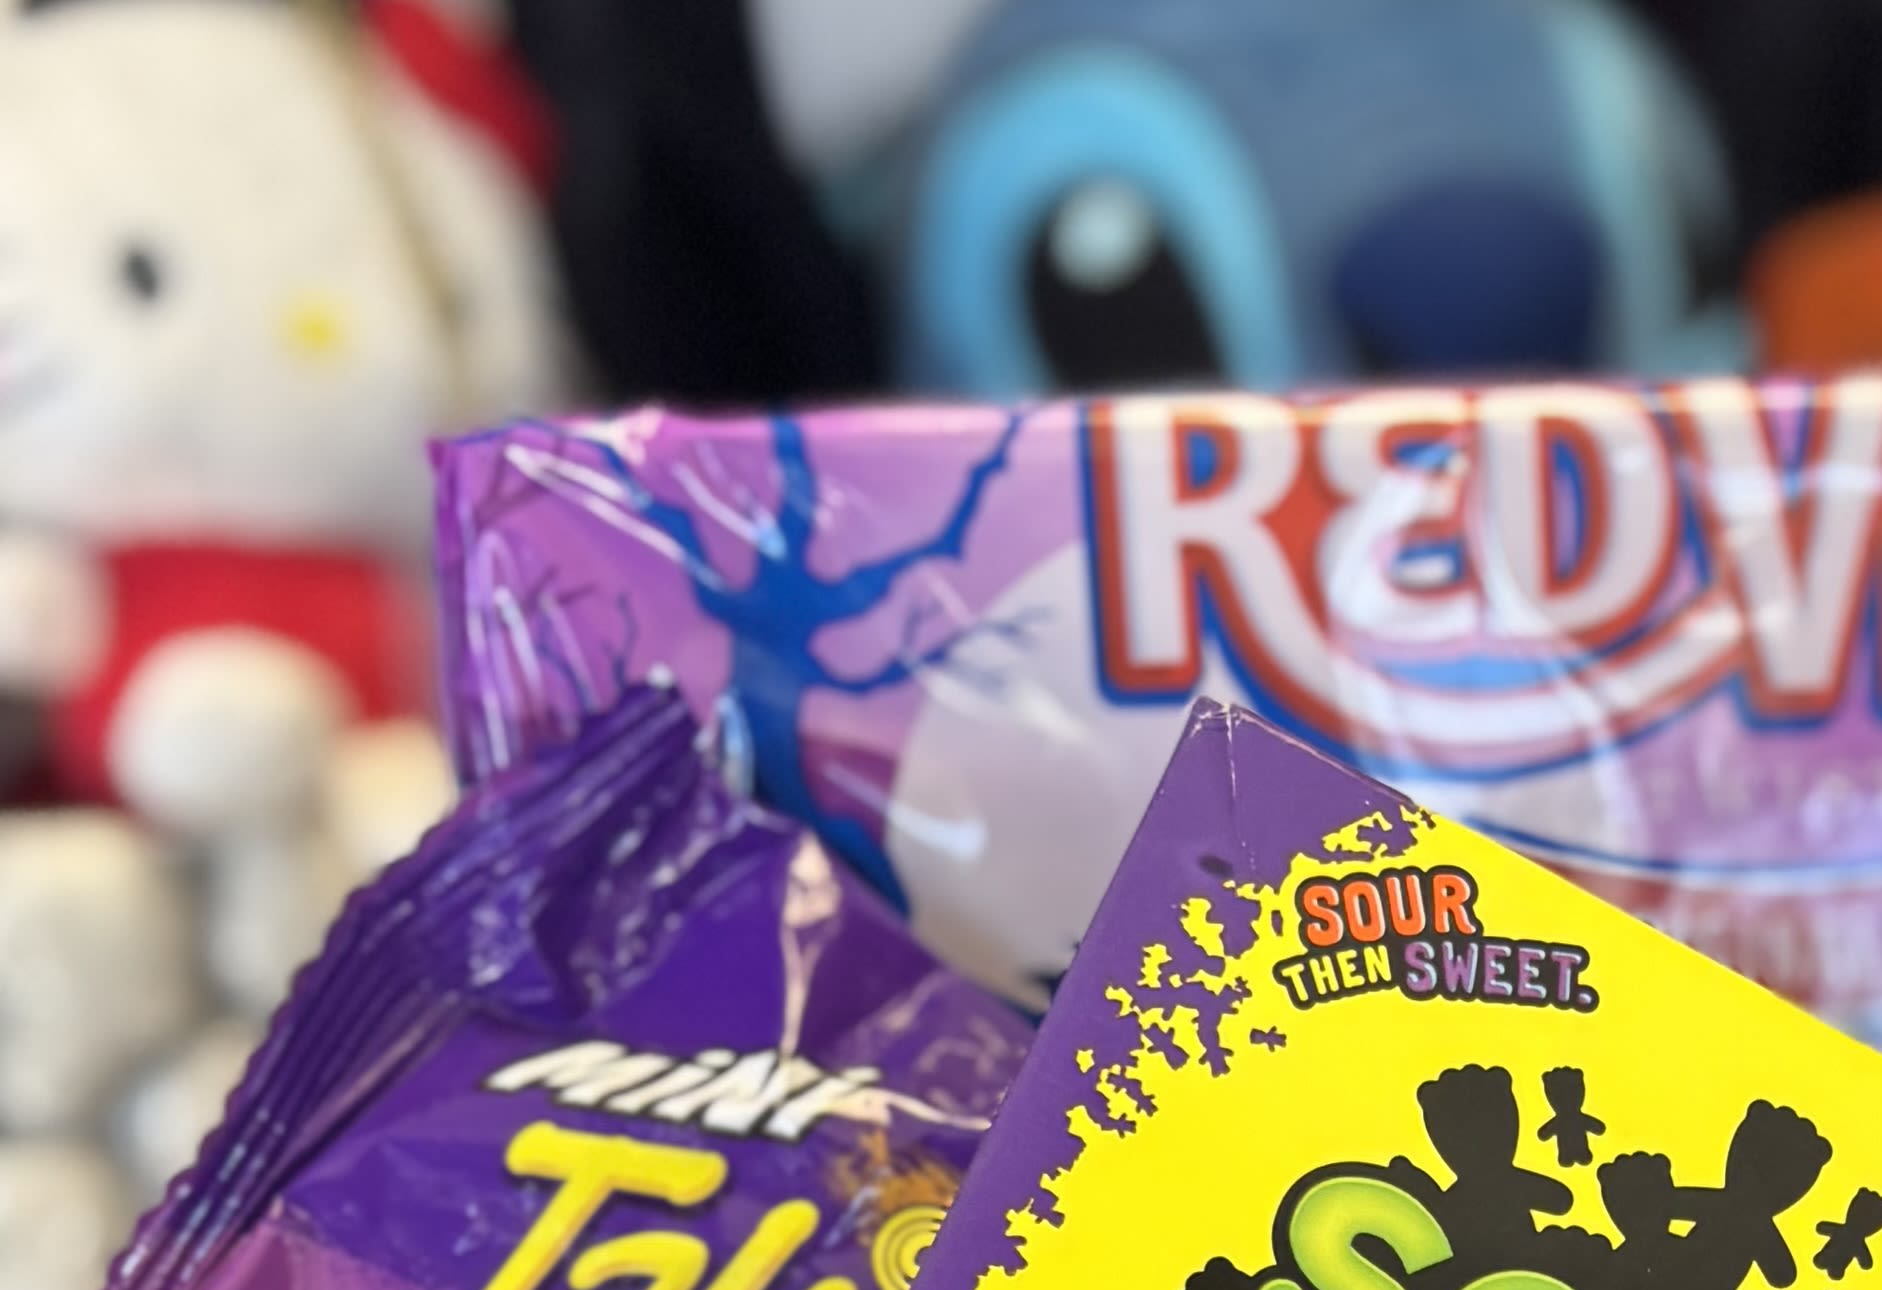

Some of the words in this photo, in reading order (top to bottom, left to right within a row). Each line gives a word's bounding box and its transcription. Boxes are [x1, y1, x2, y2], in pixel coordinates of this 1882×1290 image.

[1083, 385, 1748, 768] RED
[1303, 873, 1477, 947] SOUR
[1281, 945, 1393, 1002] THEN
[1403, 940, 1594, 1005] SWEET.
